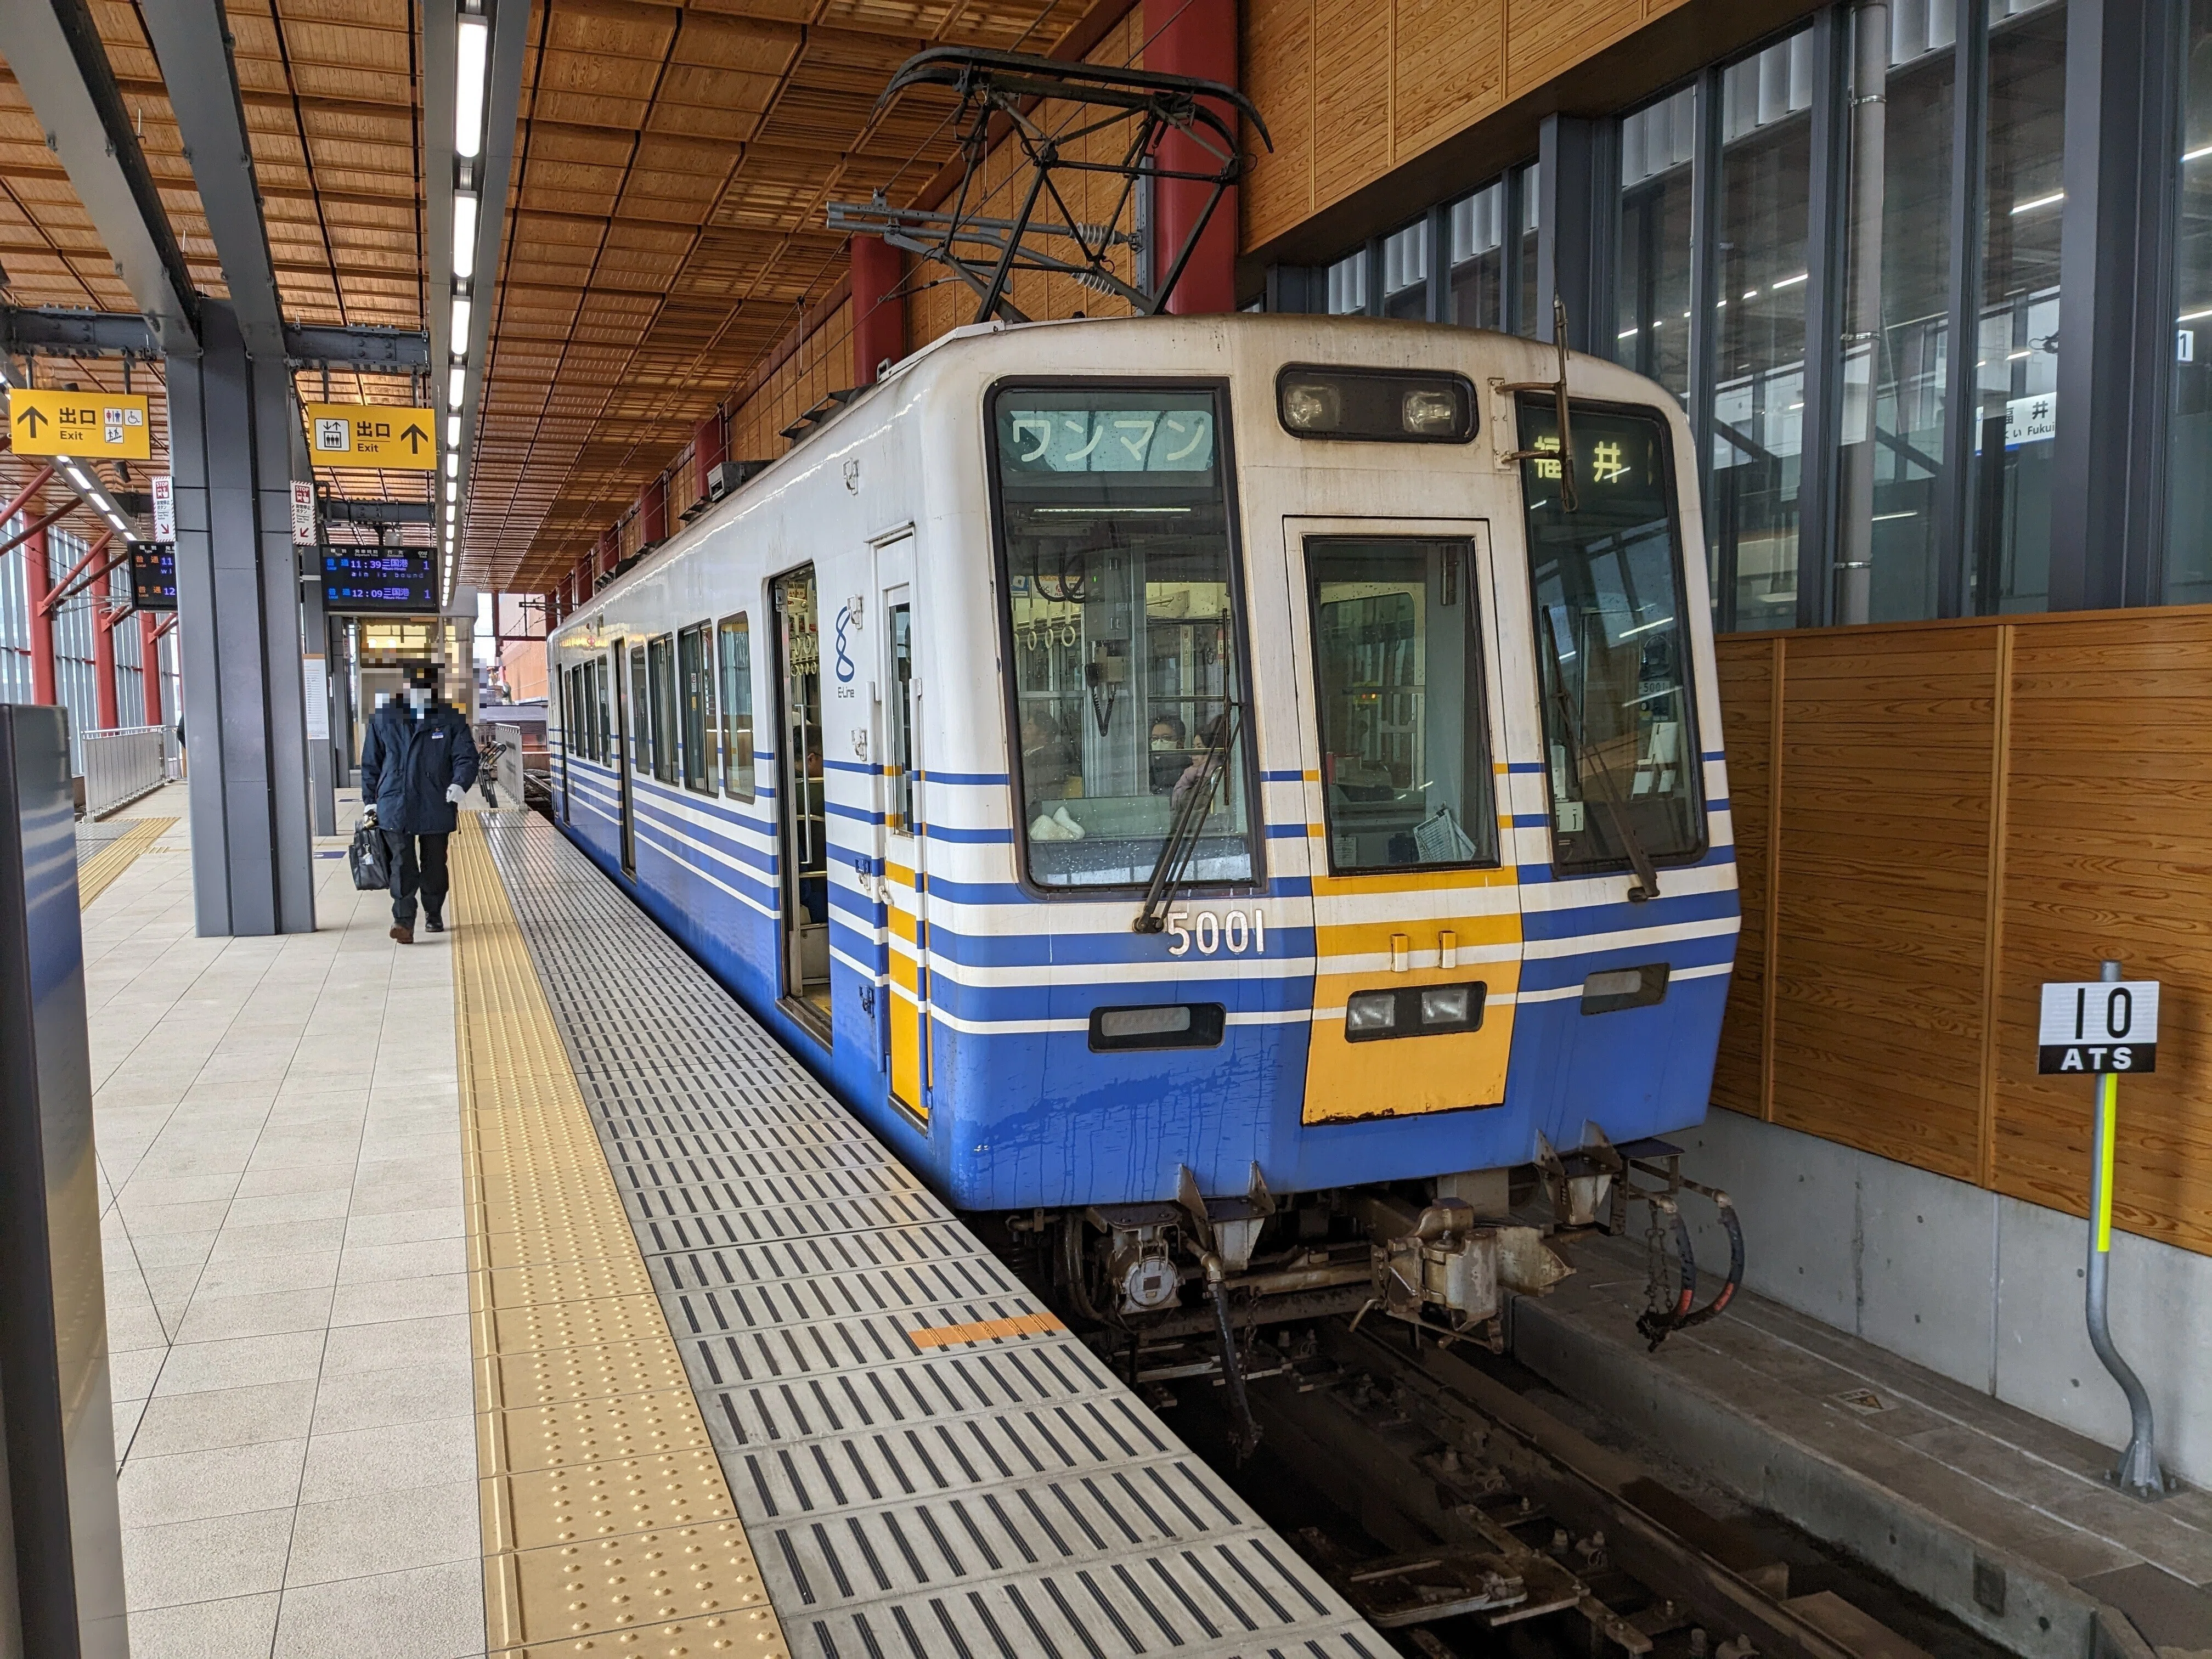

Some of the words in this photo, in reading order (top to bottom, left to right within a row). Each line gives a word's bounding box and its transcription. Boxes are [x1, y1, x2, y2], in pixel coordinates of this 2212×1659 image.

[2180, 334, 2187, 358] 1
[59, 407, 96, 425] 出口
[60, 431, 83, 441] Exit
[357, 421, 390, 438] 出口
[2028, 421, 2055, 436] Fukui
[358, 443, 379, 453] Exit
[1012, 420, 1205, 462] ワンマン
[1534, 435, 1622, 483] 福井
[351, 560, 381, 568] 11:39
[382, 558, 408, 567] 三国港
[423, 560, 430, 570] 1
[352, 589, 383, 598] 12:09
[383, 588, 410, 596] 三国港
[424, 589, 431, 599] 1
[838, 686, 855, 698] E-Line
[1167, 910, 1264, 956] 5001
[2075, 987, 2132, 1040] 10
[2061, 1047, 2132, 1070] ATS
